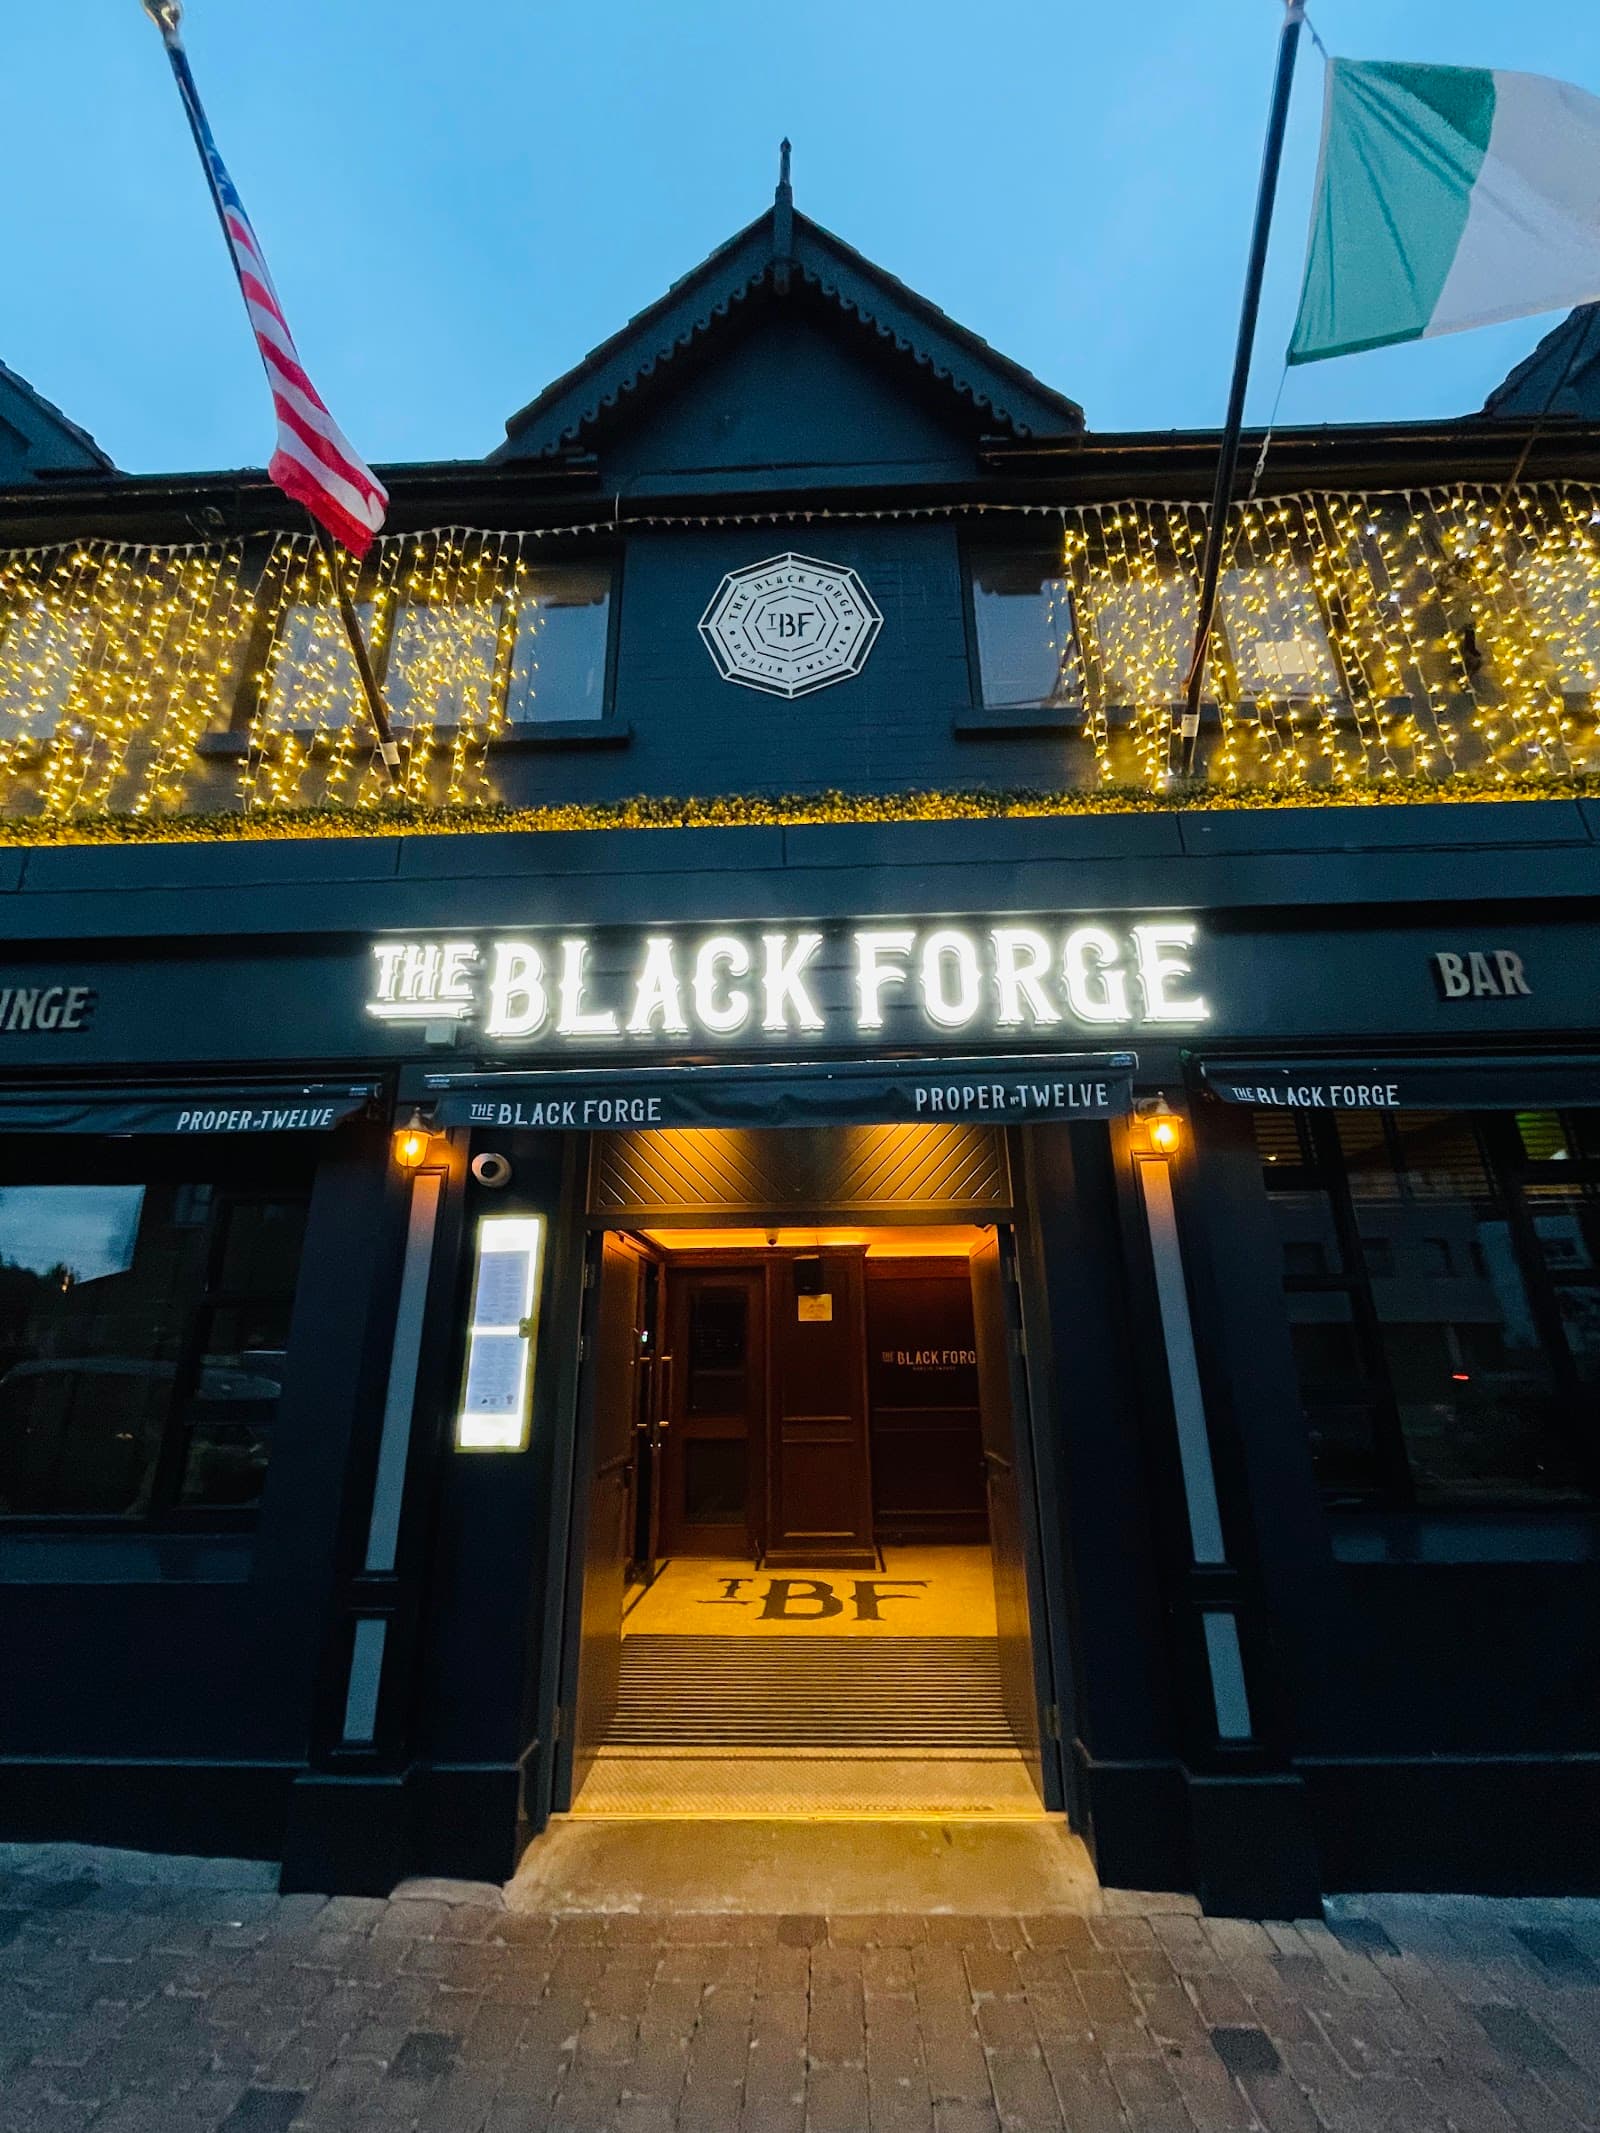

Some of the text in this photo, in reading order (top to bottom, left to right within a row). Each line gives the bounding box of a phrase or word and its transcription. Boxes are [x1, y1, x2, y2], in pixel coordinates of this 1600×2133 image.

[729, 574, 854, 620] THE BLACK FORGE
[371, 925, 1210, 1037] THE BLACK FORGE
[1434, 949, 1533, 997] BAR
[915, 1084, 1006, 1112] PROPER
[1016, 1083, 1109, 1108] TWELVE
[1231, 1084, 1400, 1107] THE BLACK FORGE
[176, 1110, 252, 1131] PROPER
[260, 1108, 334, 1129] TWELVE
[470, 1097, 662, 1125] THE BLACK FORGE
[897, 1350, 939, 1365] BLACK
